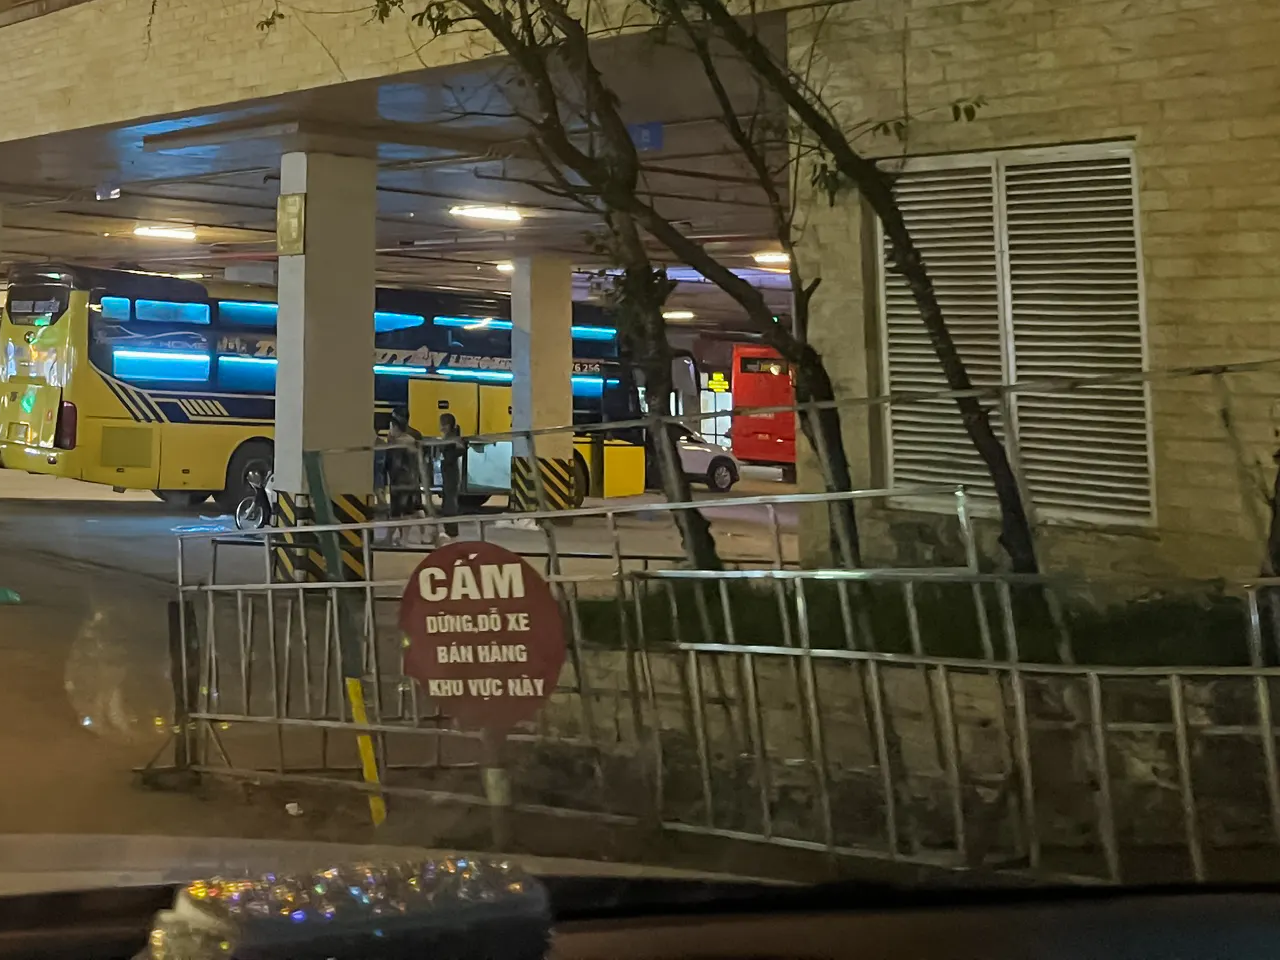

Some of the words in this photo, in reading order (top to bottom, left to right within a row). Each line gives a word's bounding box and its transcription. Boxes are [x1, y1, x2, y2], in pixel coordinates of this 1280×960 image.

[582, 363, 601, 373] 256
[418, 552, 526, 602] CẤM
[505, 612, 531, 632] XE
[436, 641, 474, 664] BÁN
[476, 640, 528, 664] HÀNG
[428, 678, 464, 697] KHU
[467, 678, 503, 701] VỰC
[507, 674, 545, 697] NÀY
